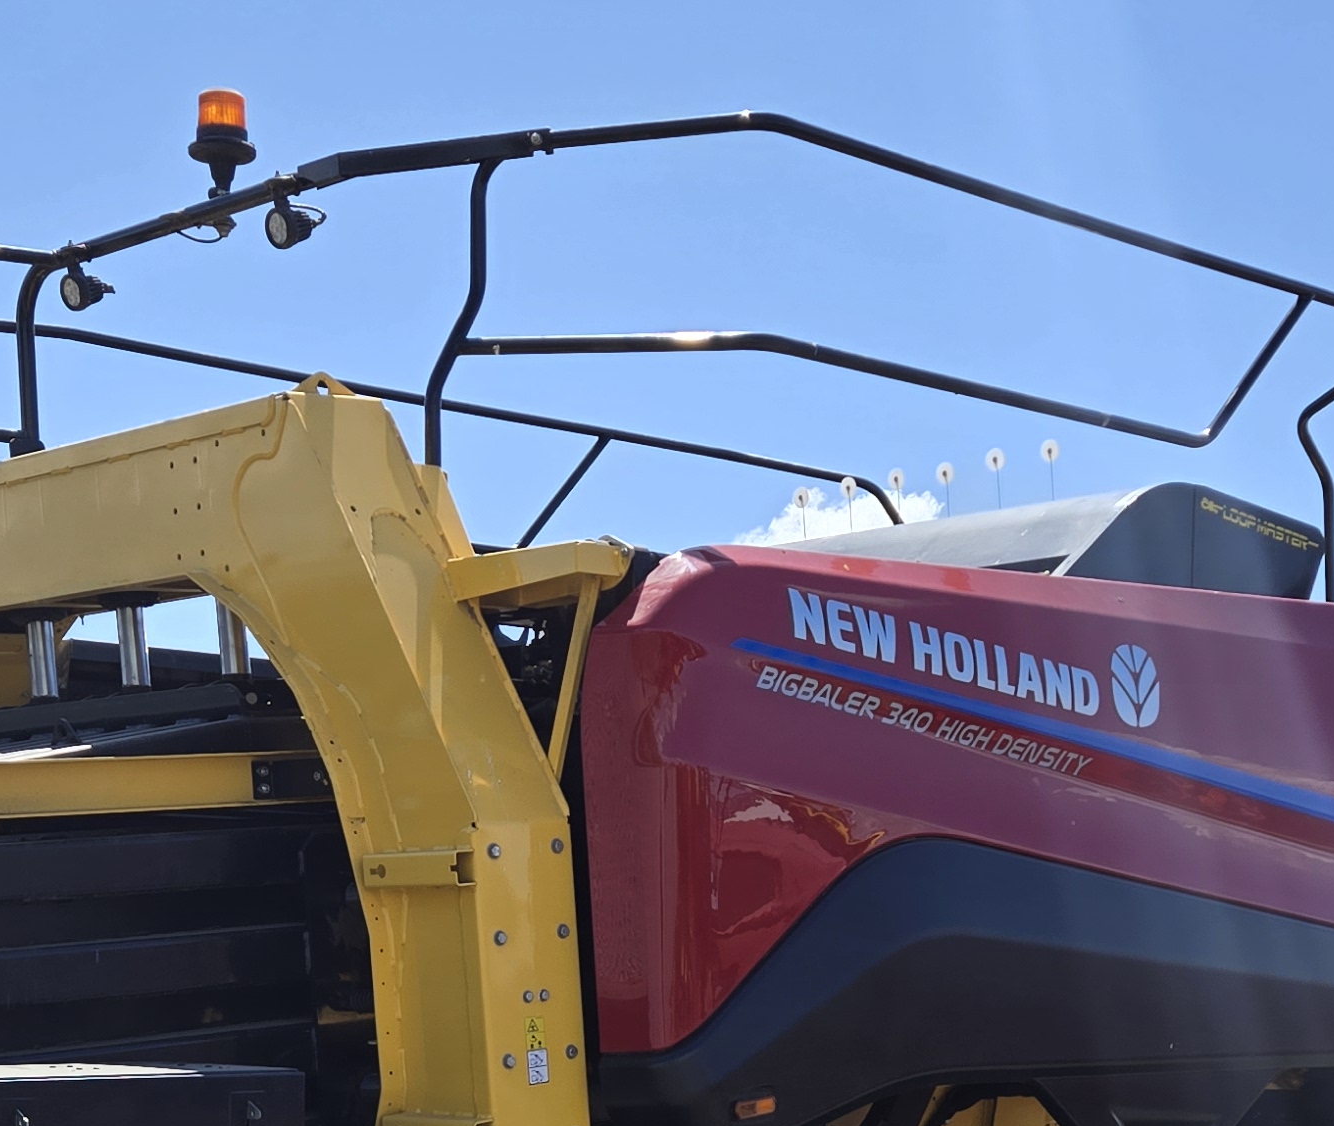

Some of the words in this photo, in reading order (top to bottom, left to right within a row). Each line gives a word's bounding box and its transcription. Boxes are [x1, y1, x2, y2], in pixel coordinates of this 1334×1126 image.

[787, 587, 896, 663] NEW
[908, 621, 1100, 716] HOLLAND
[756, 665, 881, 719] BIGBALER
[881, 702, 934, 734] 340
[935, 717, 1000, 750] HIGH
[991, 734, 1093, 776] DENSITY
